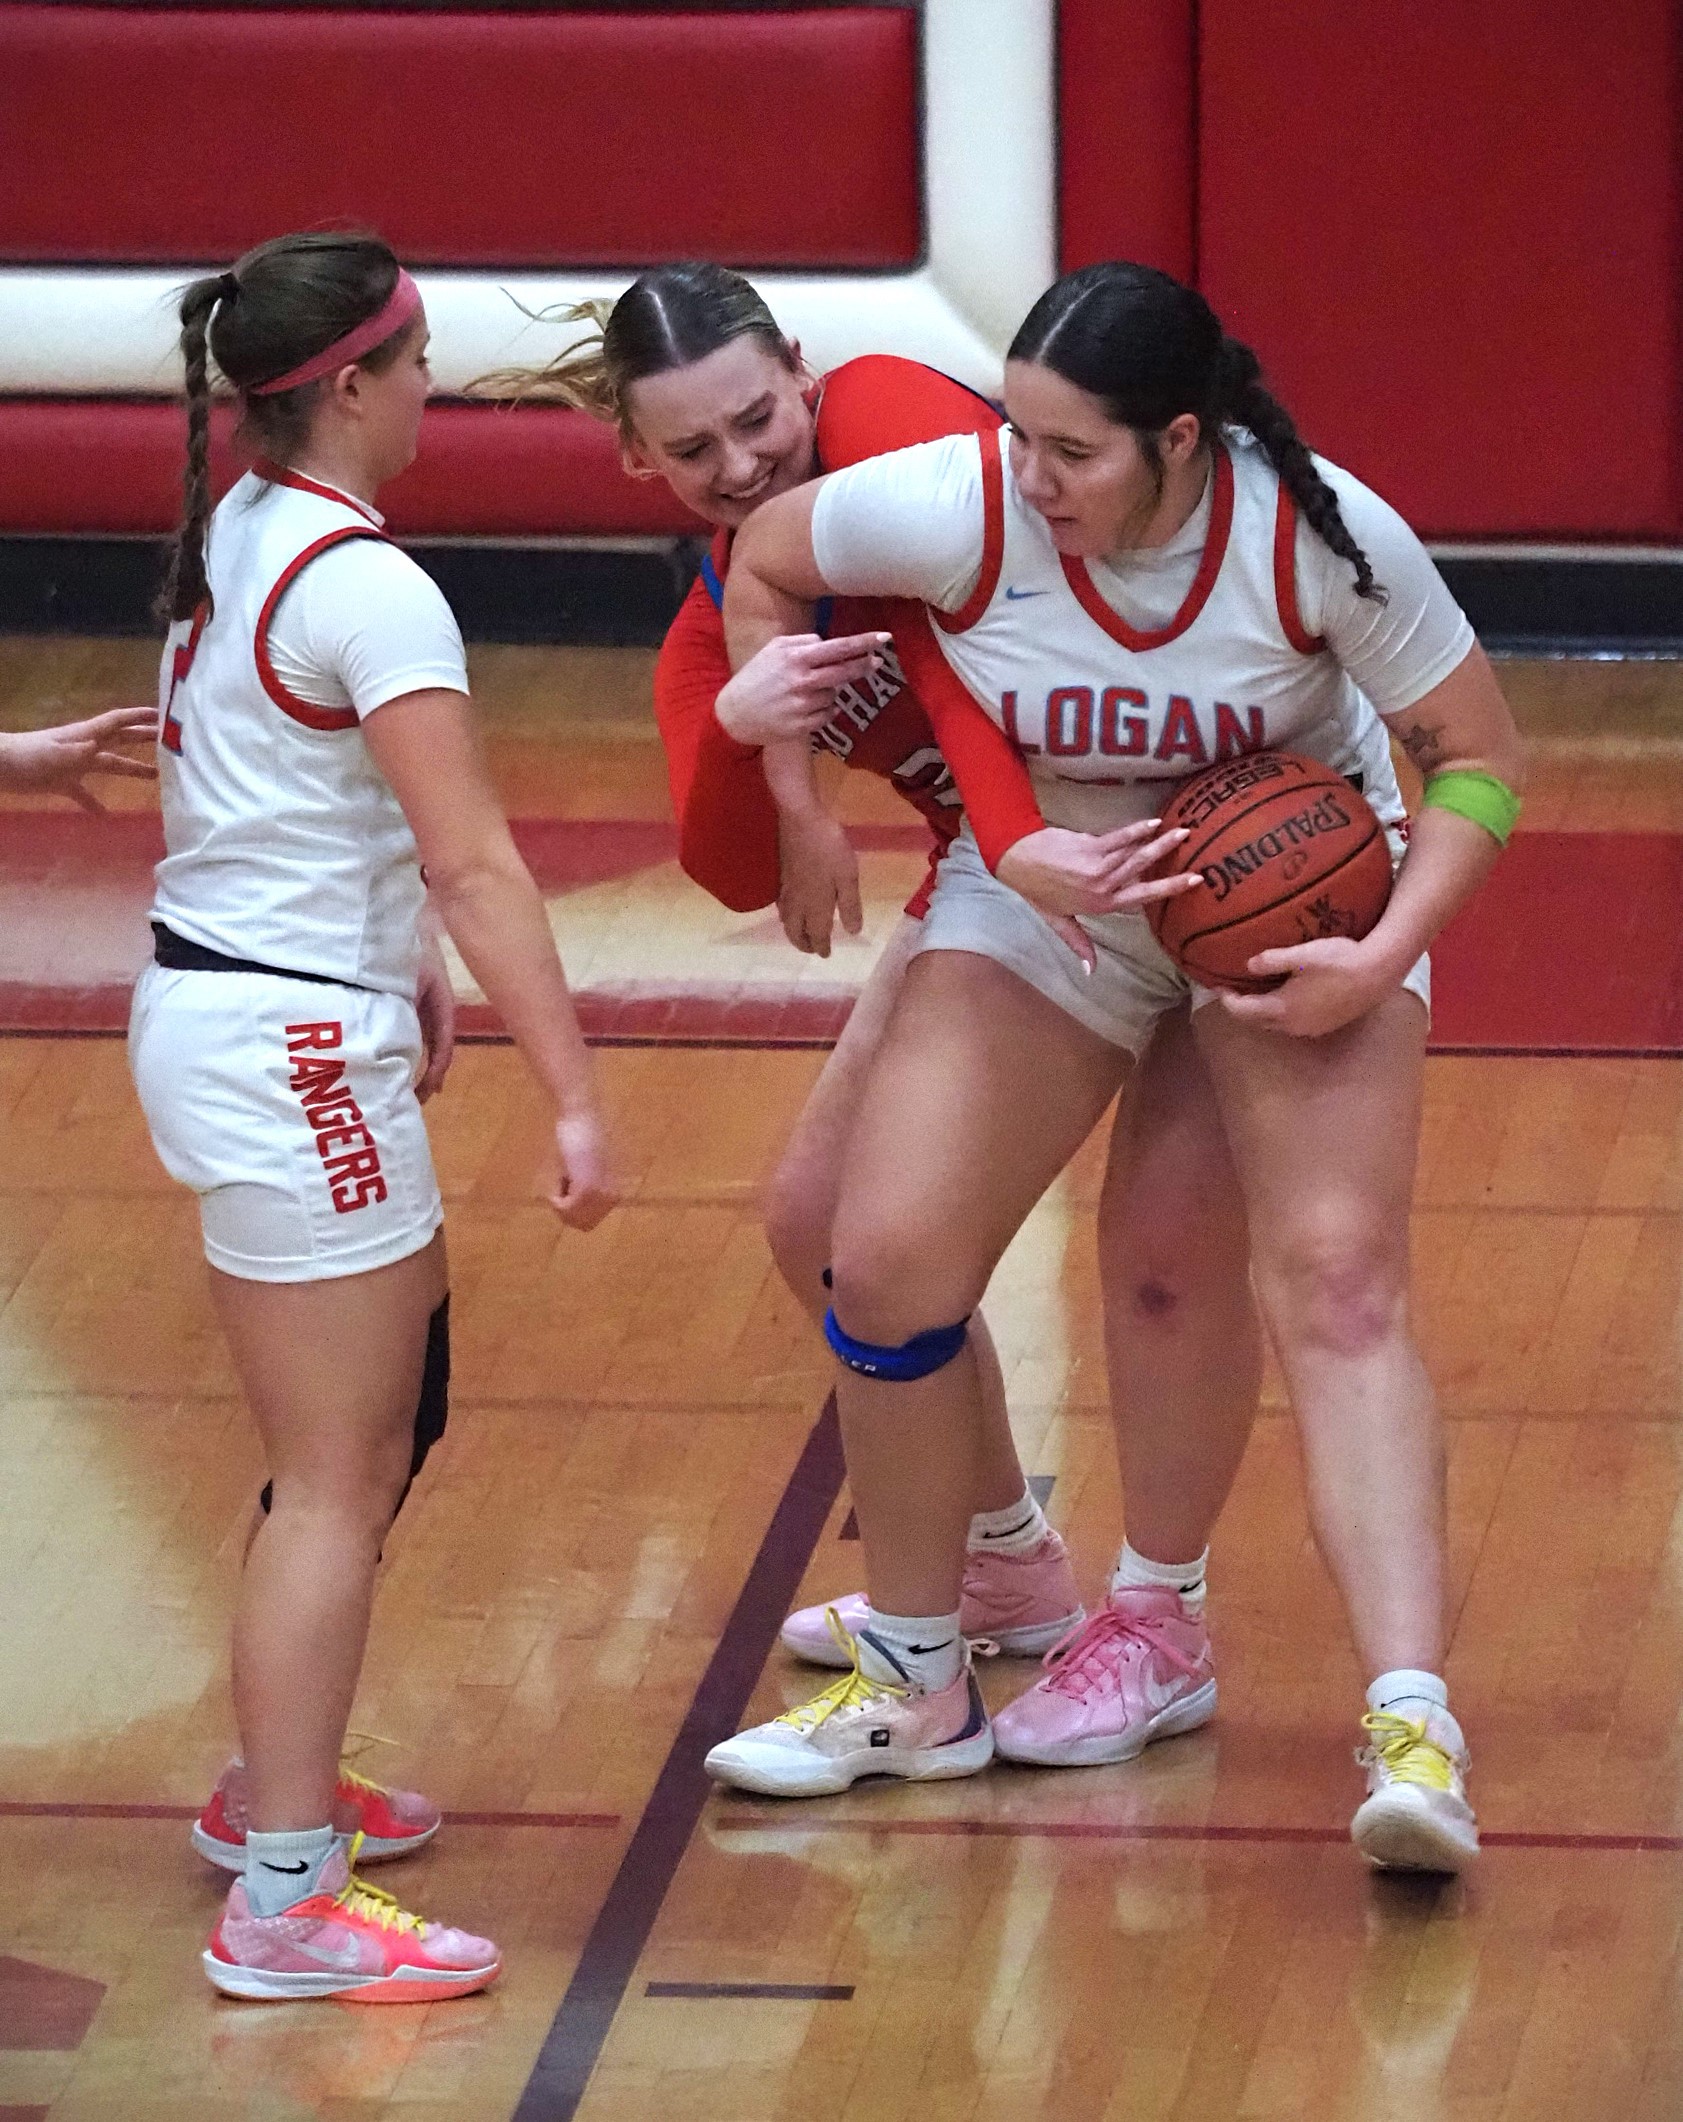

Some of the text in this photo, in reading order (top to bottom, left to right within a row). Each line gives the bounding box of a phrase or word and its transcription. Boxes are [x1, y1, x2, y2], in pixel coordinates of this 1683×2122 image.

[1001, 685, 1265, 764] LOGAN
[1202, 791, 1351, 902] SPALDING
[285, 1021, 388, 1214] RANGERS
